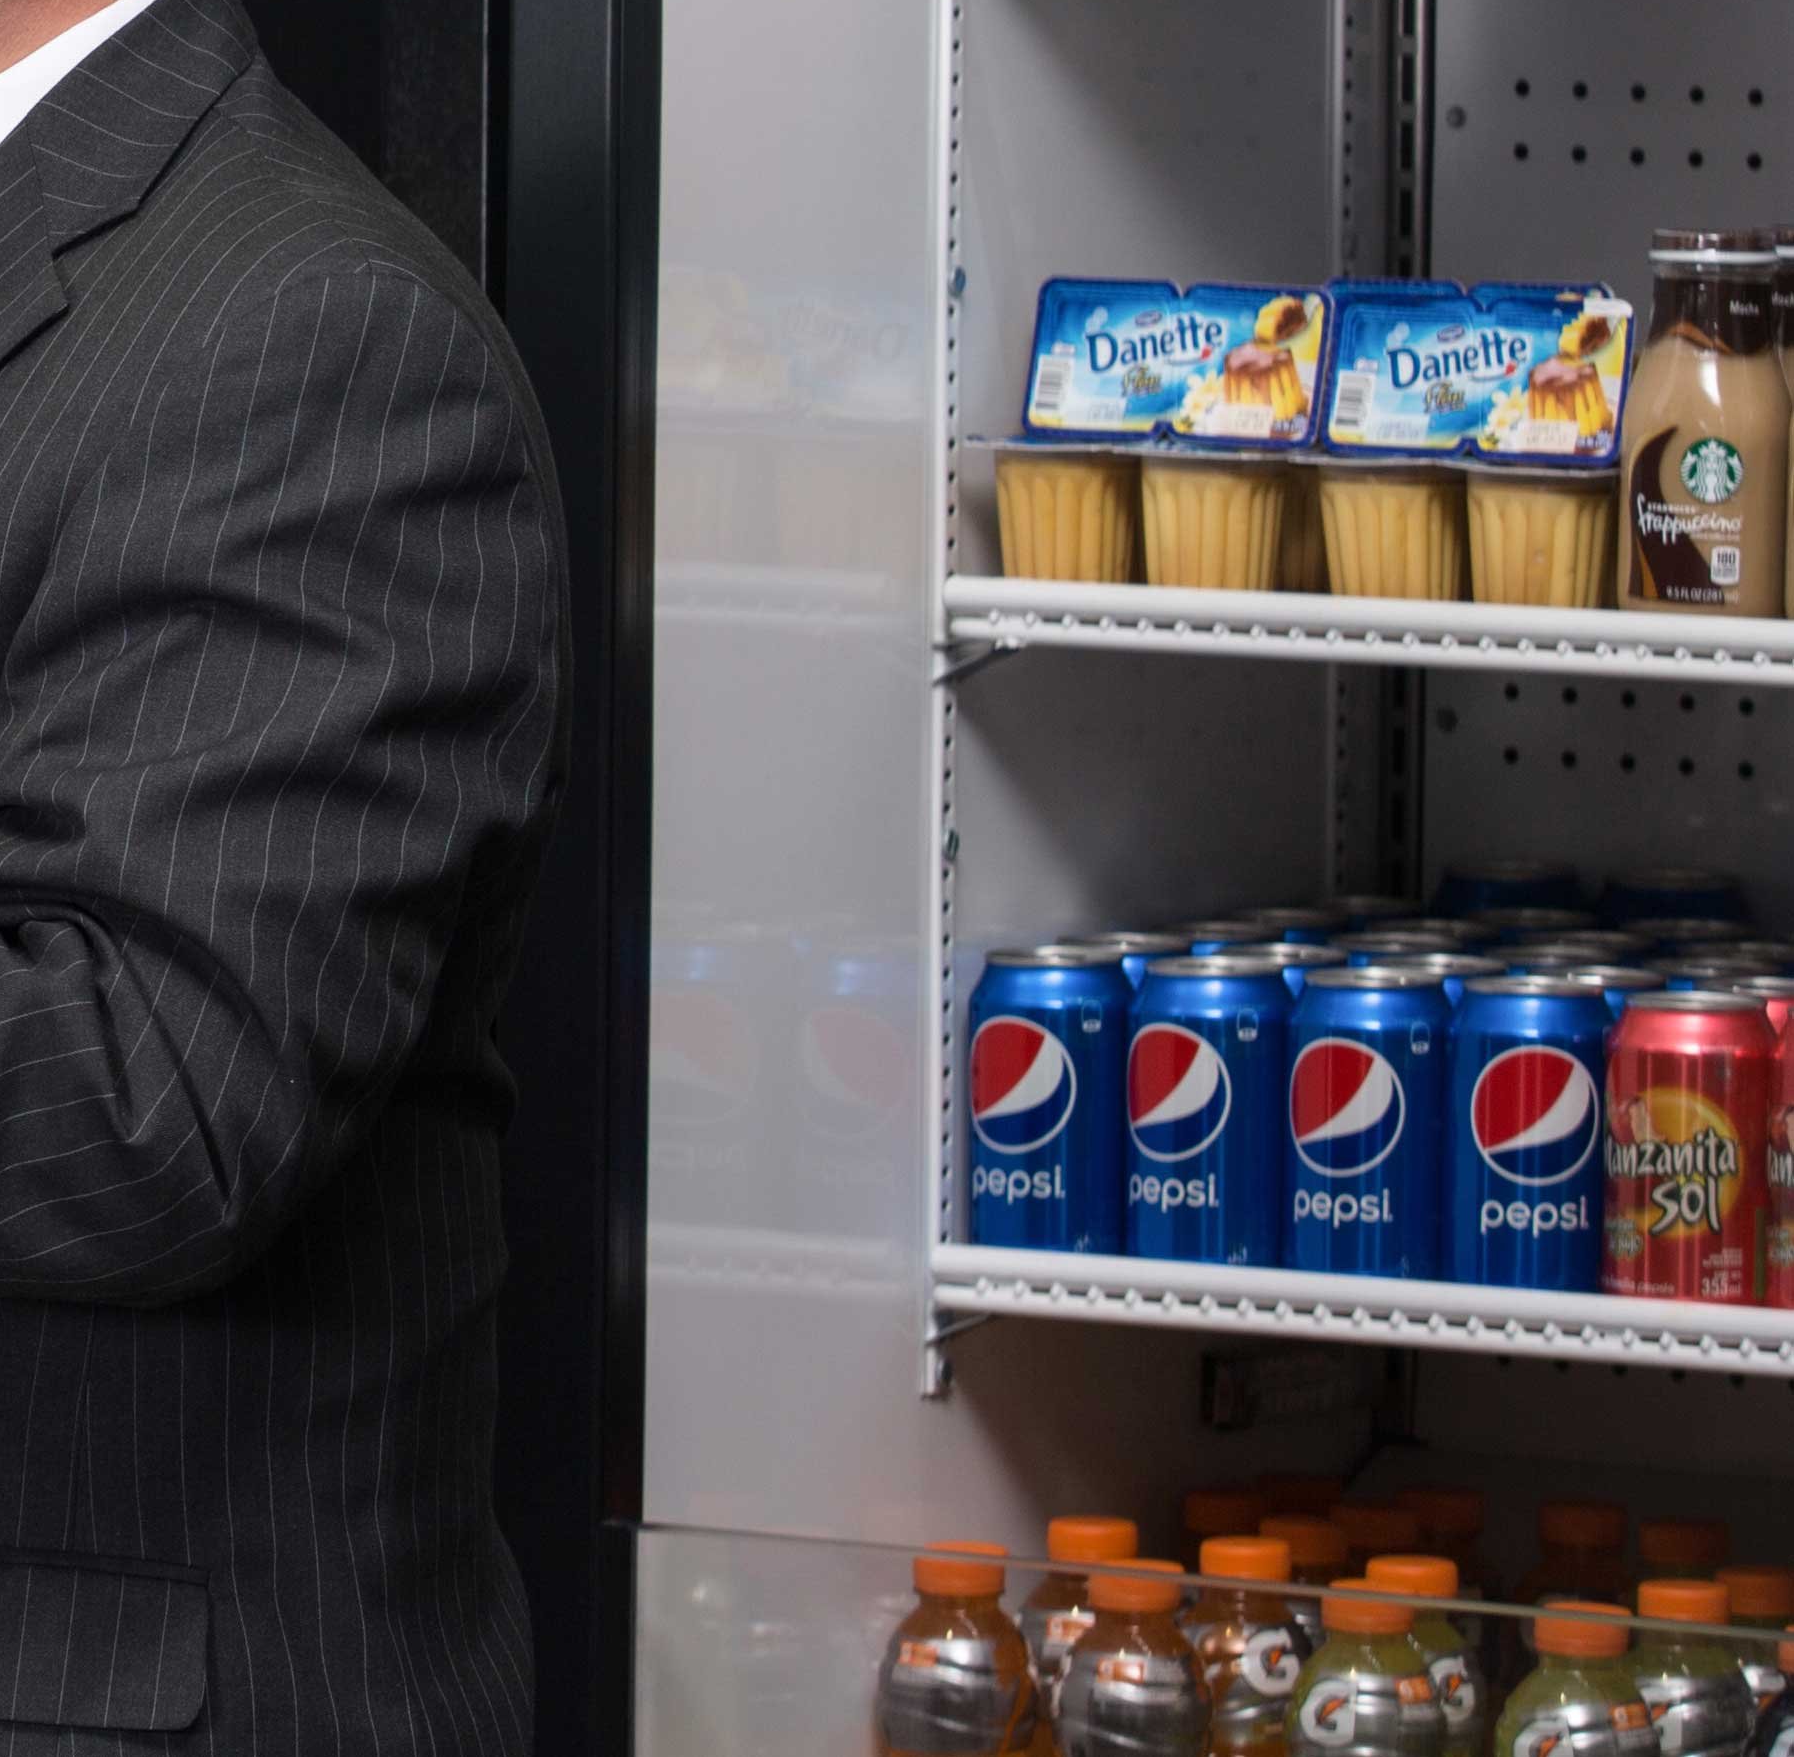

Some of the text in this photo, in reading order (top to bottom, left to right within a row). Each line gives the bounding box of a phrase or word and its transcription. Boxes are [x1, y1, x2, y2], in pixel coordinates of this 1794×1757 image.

[1085, 312, 1223, 373] Danette
[1386, 330, 1527, 389] Danette
[972, 1164, 1063, 1205] pepsi
[1129, 1174, 1217, 1213] pepsi
[1294, 1187, 1389, 1228] pepsi
[1480, 1195, 1587, 1238] pepsi
